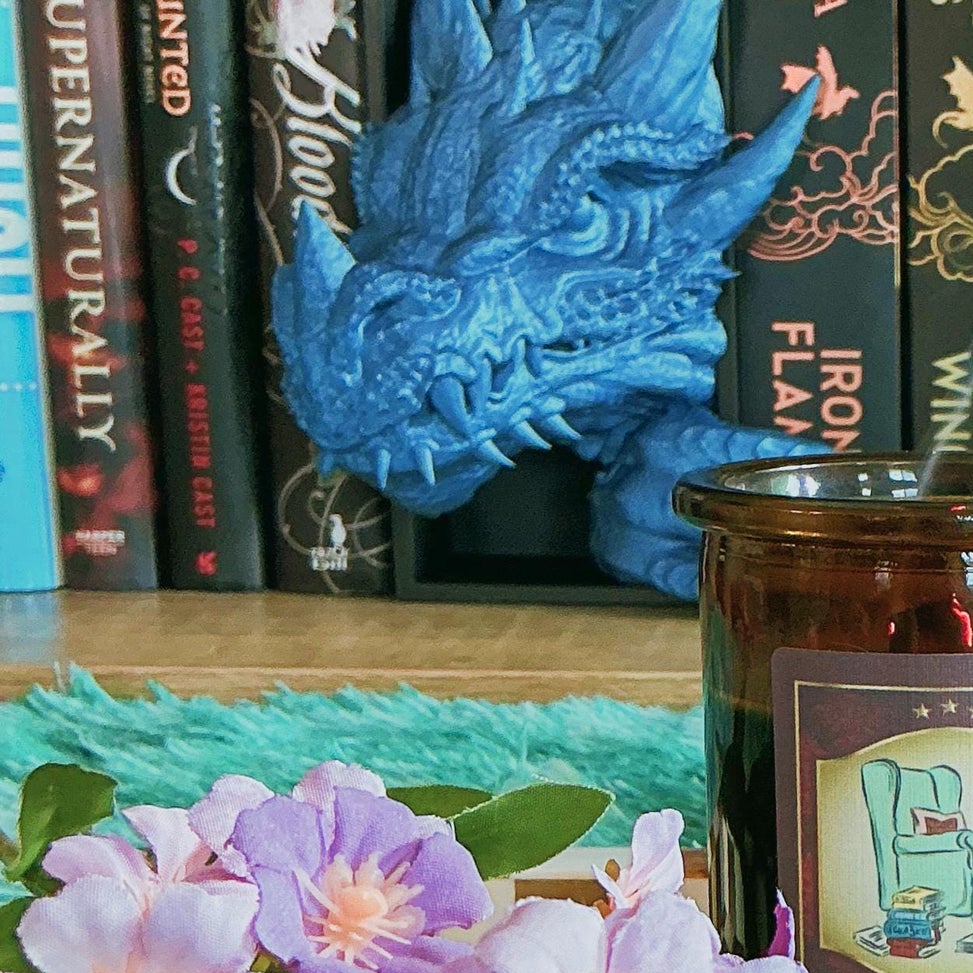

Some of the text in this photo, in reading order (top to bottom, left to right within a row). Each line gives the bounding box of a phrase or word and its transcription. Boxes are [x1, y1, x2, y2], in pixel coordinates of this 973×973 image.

[181, 296, 205, 351] CAST
[930, 351, 972, 453] WIN
[191, 476, 216, 529] CAST
